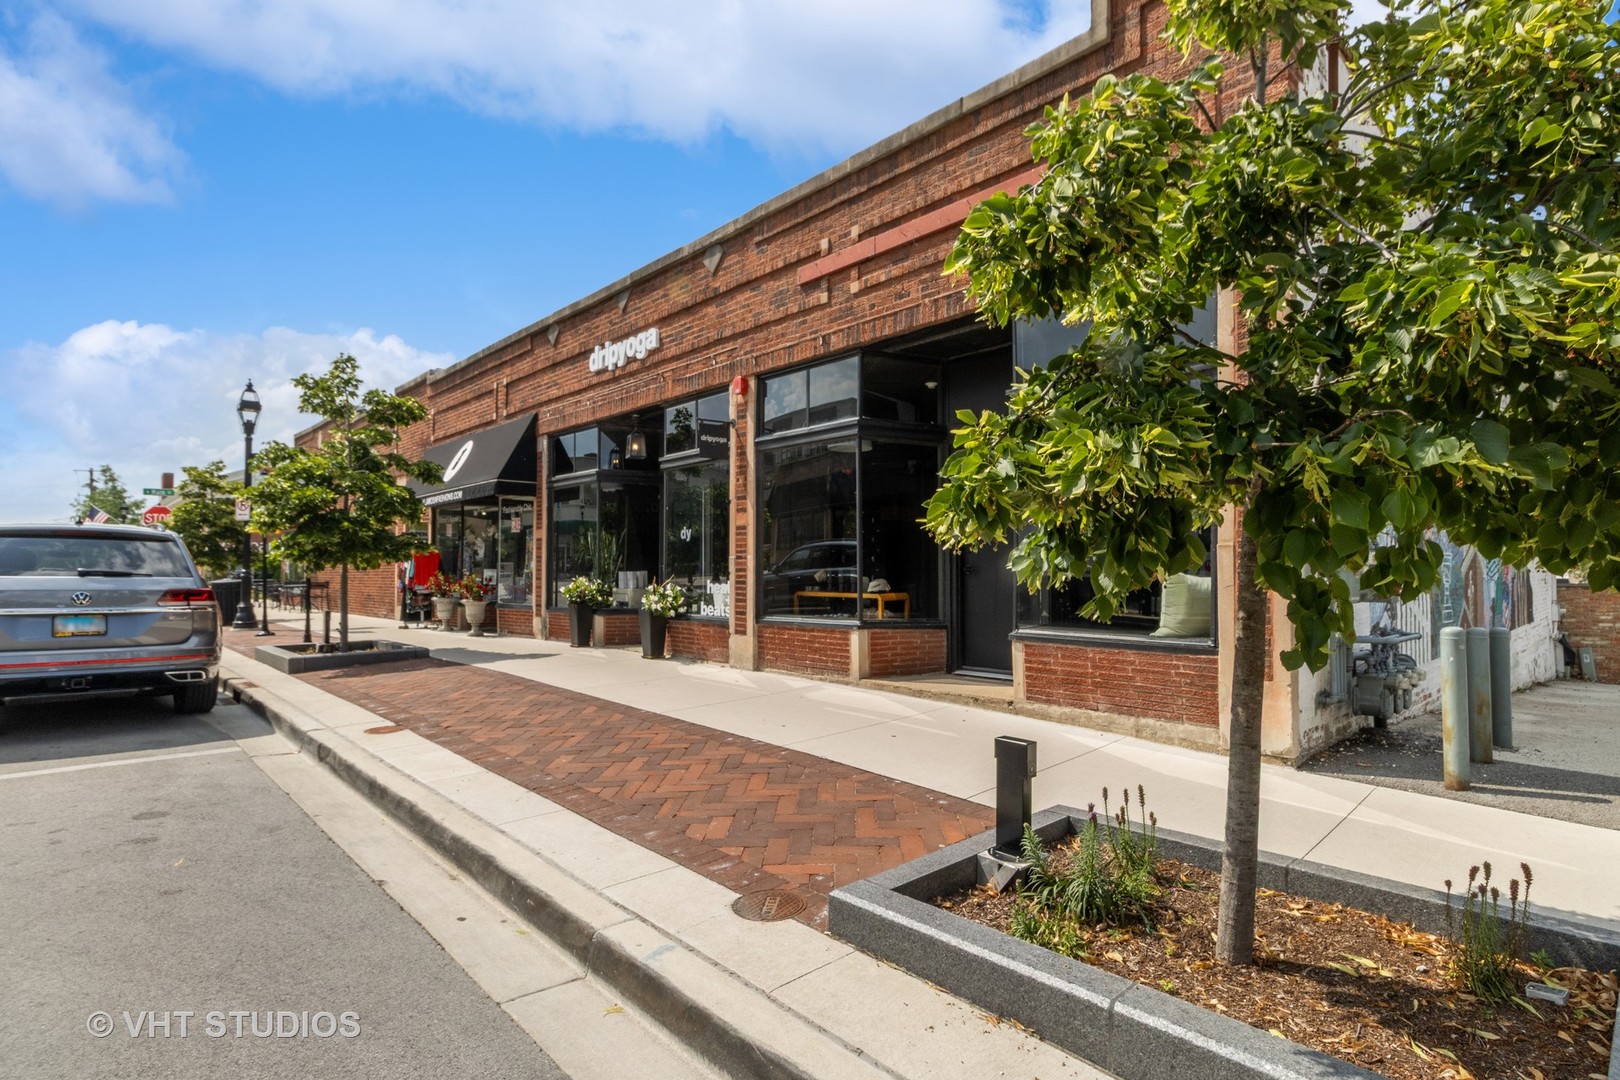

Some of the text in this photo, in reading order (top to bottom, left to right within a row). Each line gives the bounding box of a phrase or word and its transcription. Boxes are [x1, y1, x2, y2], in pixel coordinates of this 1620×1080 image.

[589, 328, 660, 372] dripyoga
[700, 434, 727, 444] dripyoga
[680, 526, 692, 541] dy
